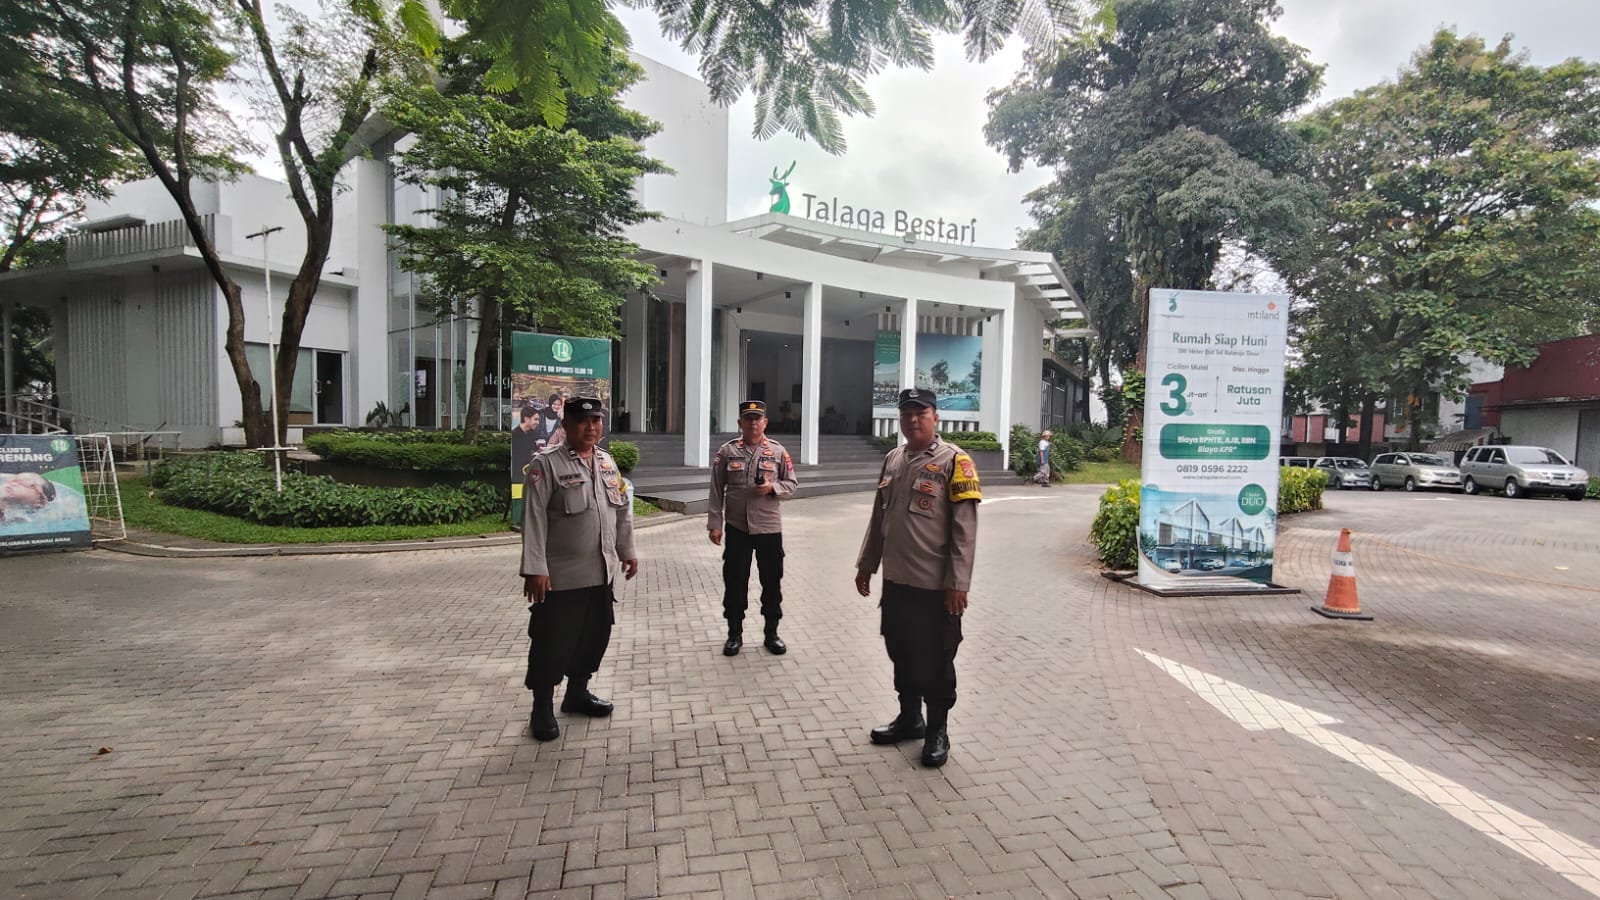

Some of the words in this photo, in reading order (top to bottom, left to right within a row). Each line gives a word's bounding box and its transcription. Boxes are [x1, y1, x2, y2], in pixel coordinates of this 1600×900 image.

[894, 210, 977, 243] Bestari
[1172, 332, 1211, 345] Rumah
[1214, 332, 1237, 348] Siap
[1241, 336, 1268, 347] Huni
[1166, 363, 1190, 371] Cicilan
[1247, 367, 1270, 375] Hingga
[1159, 372, 1187, 417] 3
[1226, 384, 1272, 395] Ratusan
[1236, 396, 1261, 406] Juta
[1176, 435, 1198, 445] Biaya
[1197, 445, 1218, 454] Biaya
[1176, 464, 1199, 473] 0819
[1201, 465, 1225, 473] 0596
[1226, 465, 1249, 473] 2222
[1241, 497, 1264, 506] DUO
